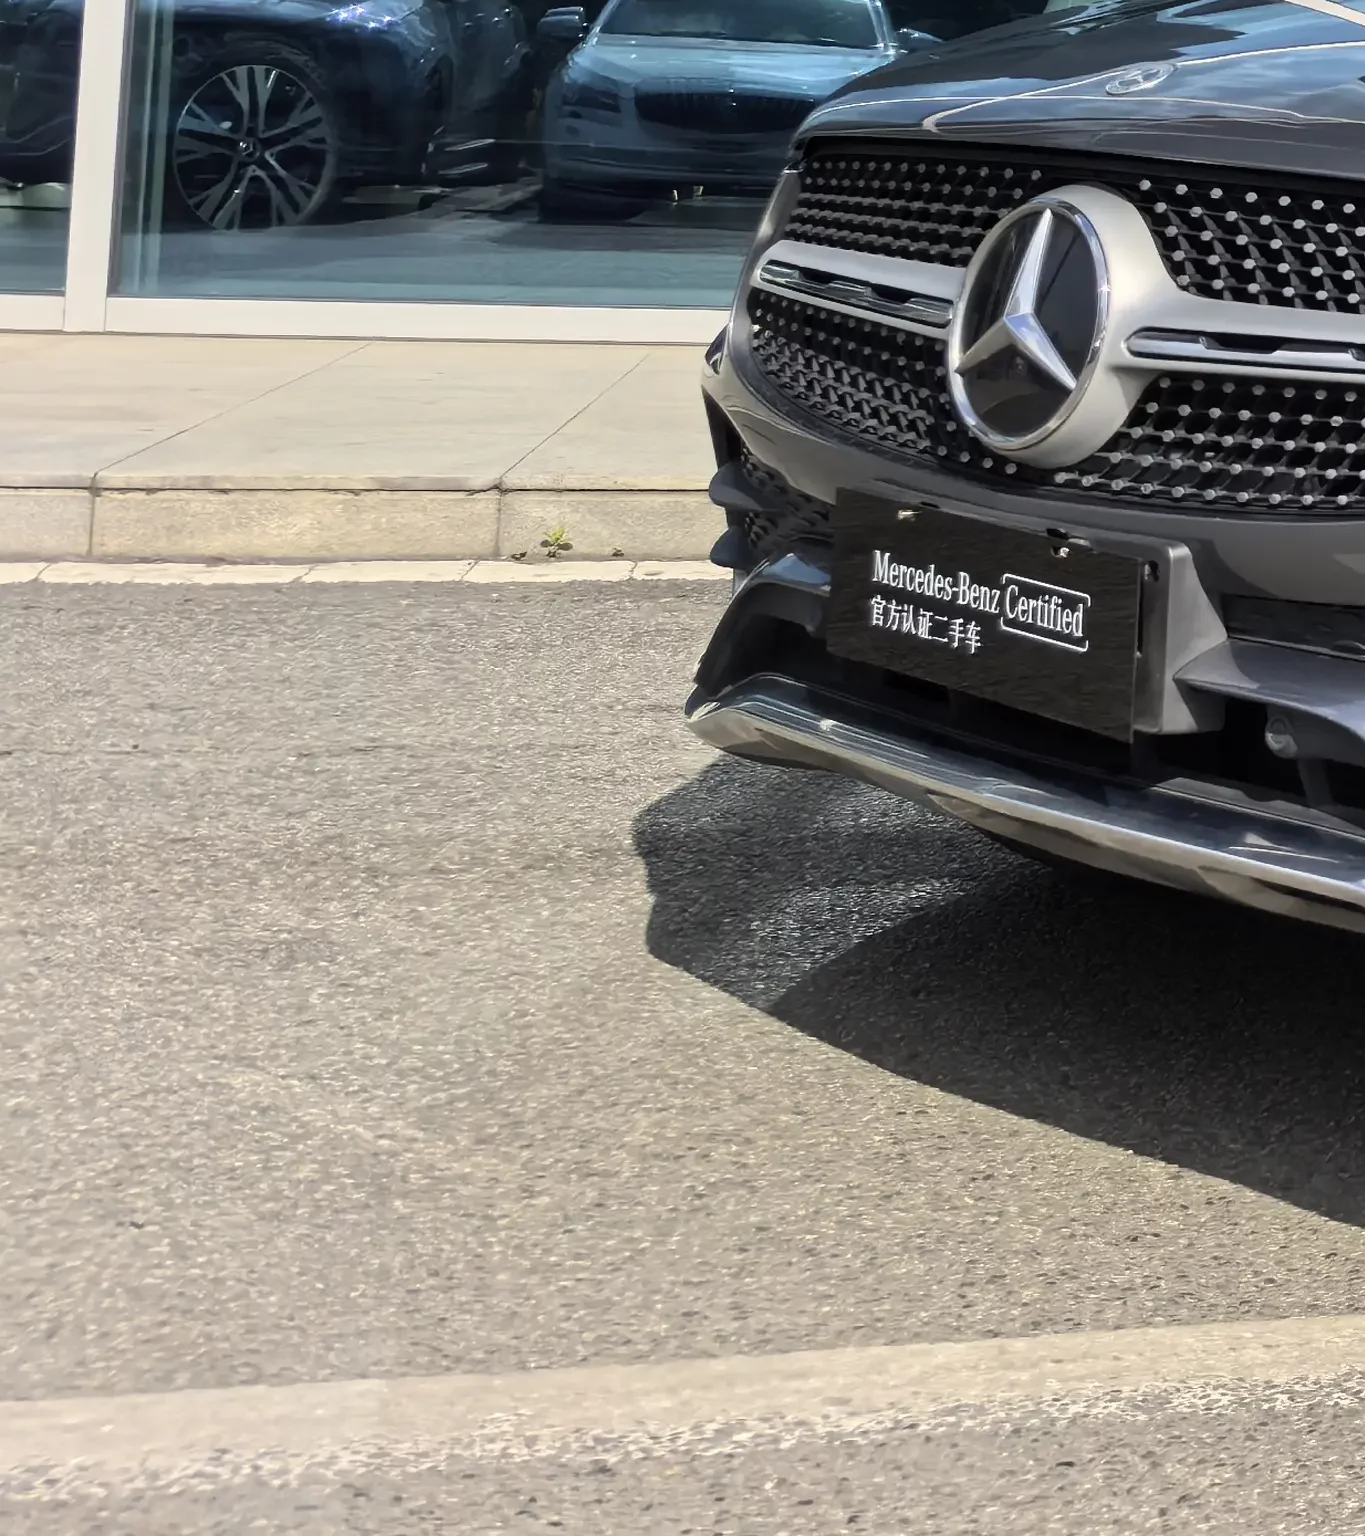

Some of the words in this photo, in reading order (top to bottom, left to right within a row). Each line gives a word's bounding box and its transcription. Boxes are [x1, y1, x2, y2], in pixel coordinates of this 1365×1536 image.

[870, 594, 982, 655] 官方认证二手车
[871, 550, 1000, 614] Mercedes-Benz
[1004, 584, 1085, 637] Certified
